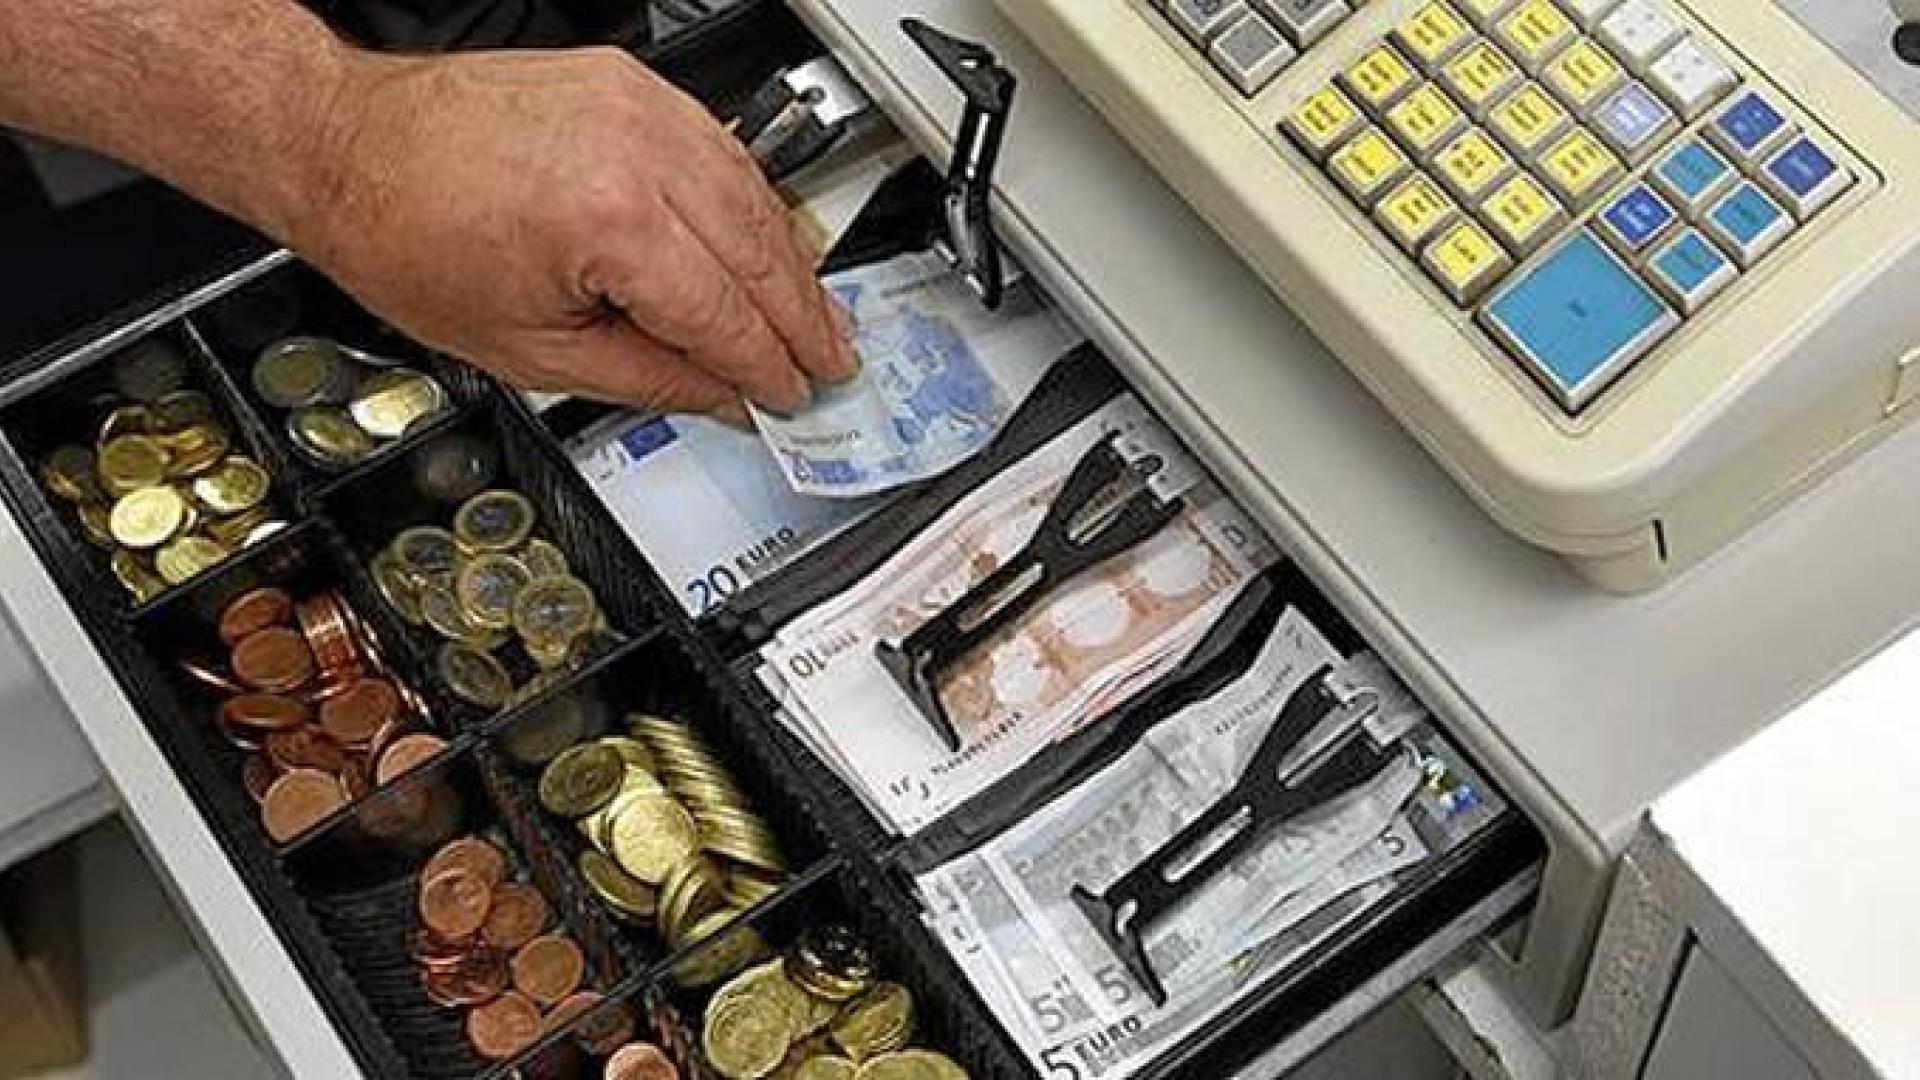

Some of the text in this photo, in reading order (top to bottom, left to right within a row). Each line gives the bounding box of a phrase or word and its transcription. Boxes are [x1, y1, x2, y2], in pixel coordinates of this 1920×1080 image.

[686, 526, 794, 617] 20 EURO
[1038, 1014, 1142, 1080] 5 EURO
